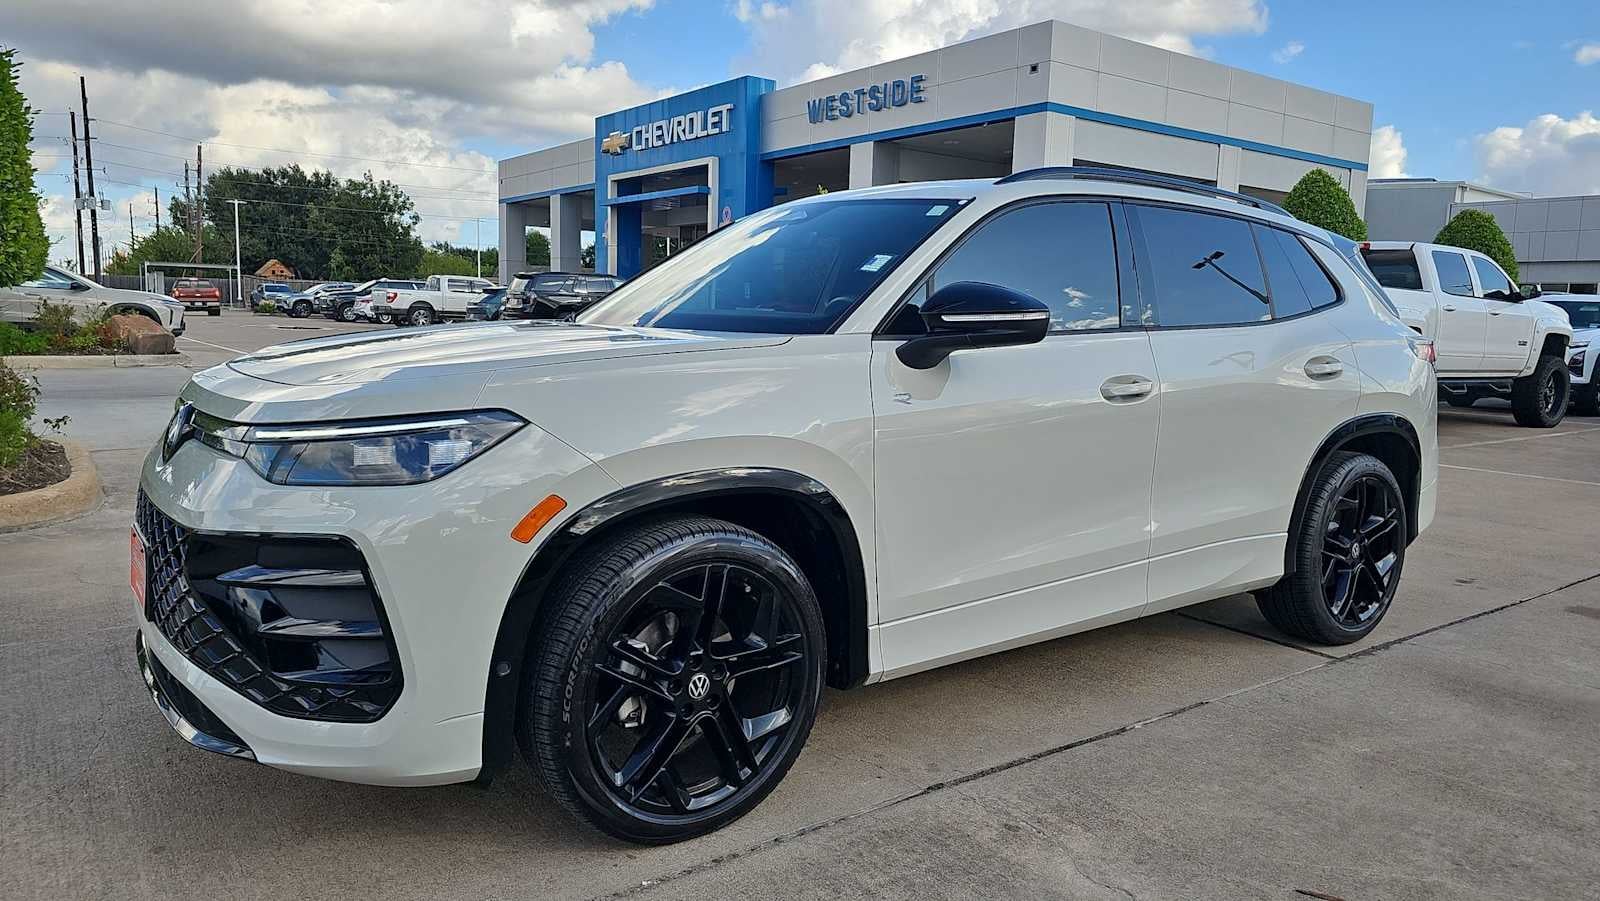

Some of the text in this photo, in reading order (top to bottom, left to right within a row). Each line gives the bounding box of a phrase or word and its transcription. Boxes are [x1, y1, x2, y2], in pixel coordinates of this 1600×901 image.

[807, 74, 927, 124] WESTSIDE
[632, 103, 734, 151] CHEVROLET
[562, 623, 596, 724] SCORPION
